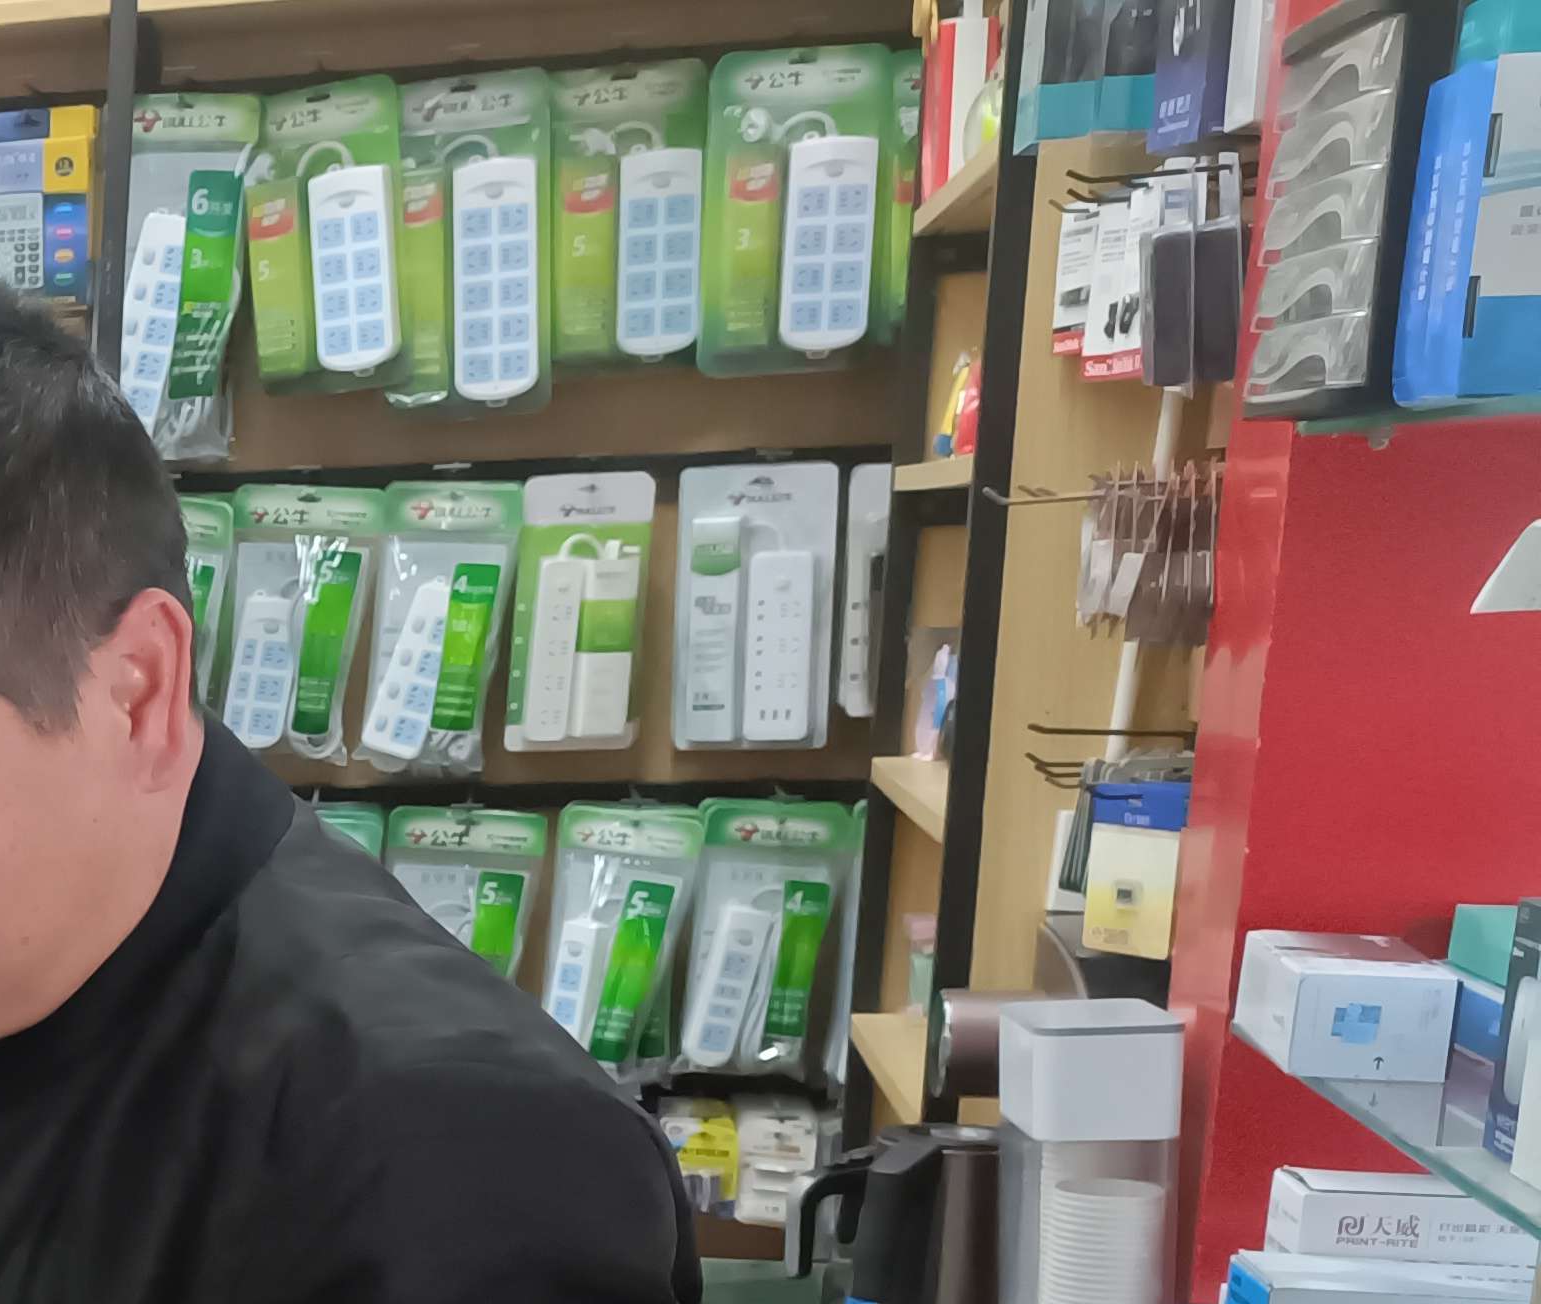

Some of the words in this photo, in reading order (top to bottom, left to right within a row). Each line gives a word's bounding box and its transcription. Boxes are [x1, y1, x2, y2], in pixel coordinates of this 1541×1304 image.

[191, 187, 210, 216] 6
[571, 233, 588, 257] 5
[479, 880, 498, 905] 5
[1335, 1235, 1418, 1249] PRINT-RITE
